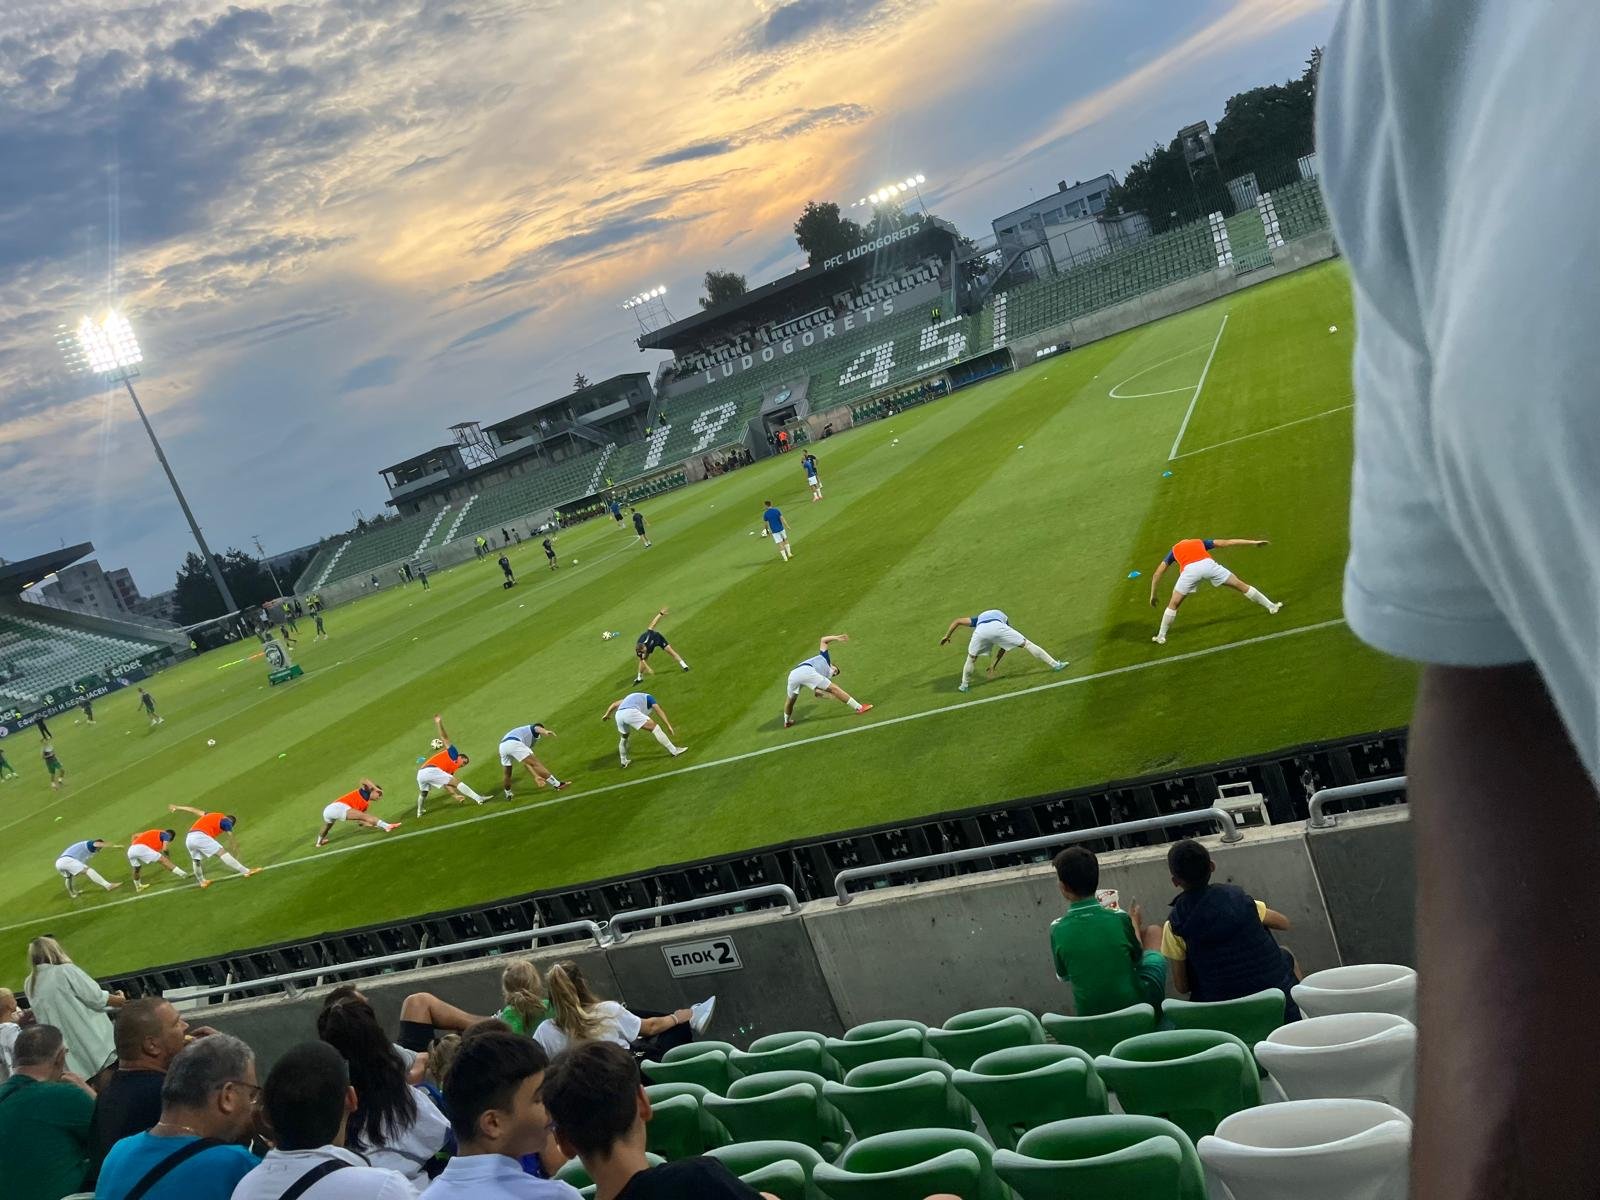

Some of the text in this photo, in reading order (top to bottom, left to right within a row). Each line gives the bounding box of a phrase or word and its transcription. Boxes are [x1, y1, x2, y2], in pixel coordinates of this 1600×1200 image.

[823, 222, 920, 271] PFC LUDOGORETS
[705, 299, 894, 384] LUDOGORETS
[111, 659, 143, 677] efbet
[670, 942, 735, 967] БЛОК 2
